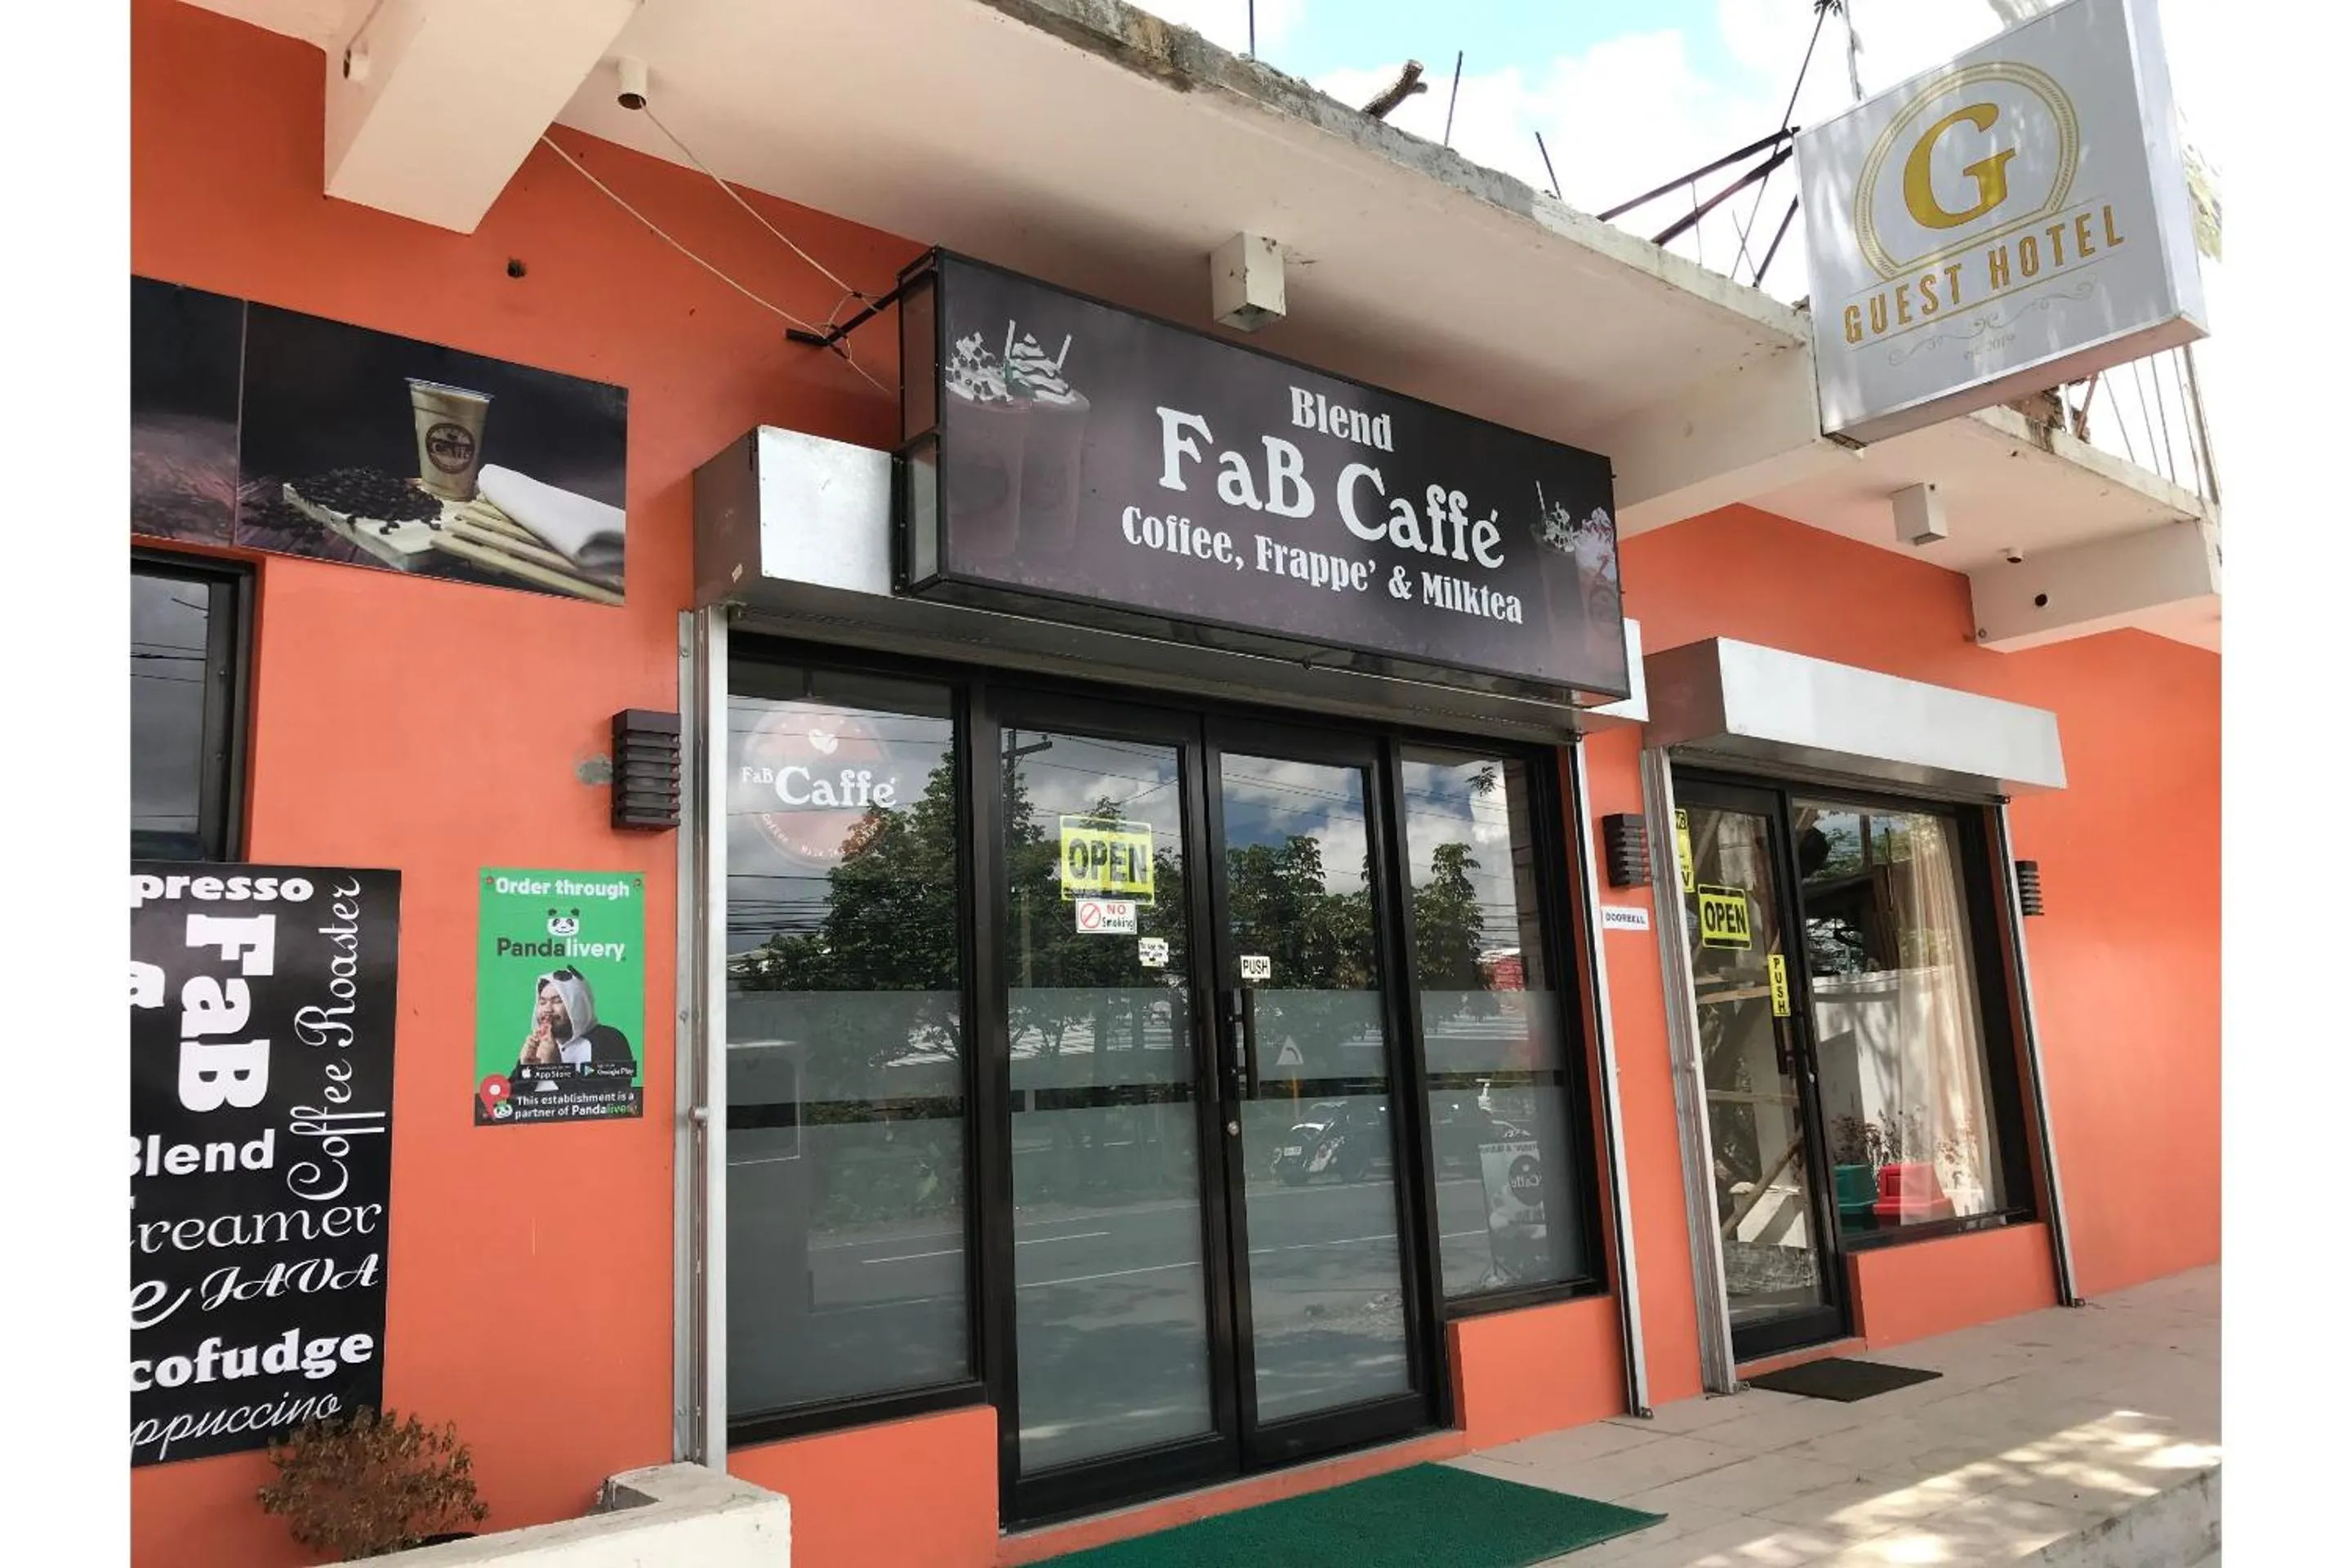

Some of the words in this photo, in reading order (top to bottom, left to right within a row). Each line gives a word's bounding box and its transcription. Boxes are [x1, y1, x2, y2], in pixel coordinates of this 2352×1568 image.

[1904, 103, 2016, 229] G
[1844, 263, 1962, 345] GUEST
[1988, 204, 2125, 291] HOTEL
[1290, 385, 1394, 452] Blend
[1156, 406, 1316, 519] FaB
[1337, 462, 1504, 569] Caffé
[1122, 505, 1244, 571] Coffee,
[1388, 565, 1413, 600] &
[1422, 571, 1523, 625] Milktea
[742, 766, 774, 784] FaB
[1068, 837, 1147, 884] OPEN
[130, 874, 314, 909] presso
[496, 876, 552, 895] Order
[555, 879, 630, 901] through
[1107, 903, 1127, 915] NO
[1102, 916, 1135, 931] Smoking
[1704, 901, 1748, 935] OPEN
[294, 875, 362, 1049] Roaster
[497, 937, 626, 962] Pandalivery
[1242, 959, 1268, 975] PUSH
[1773, 957, 1787, 1013] PUSH
[178, 914, 276, 1112] FaB
[514, 1108, 555, 1120] partner
[558, 1106, 569, 1116] of
[516, 1095, 539, 1107] This
[541, 1092, 616, 1104] establishment
[617, 1091, 626, 1101] is
[628, 1092, 635, 1101] a
[287, 1058, 386, 1201] Coffee
[130, 1204, 382, 1254] reamer
[201, 1253, 379, 1312] JAVA
[130, 1328, 375, 1392] cofudge
